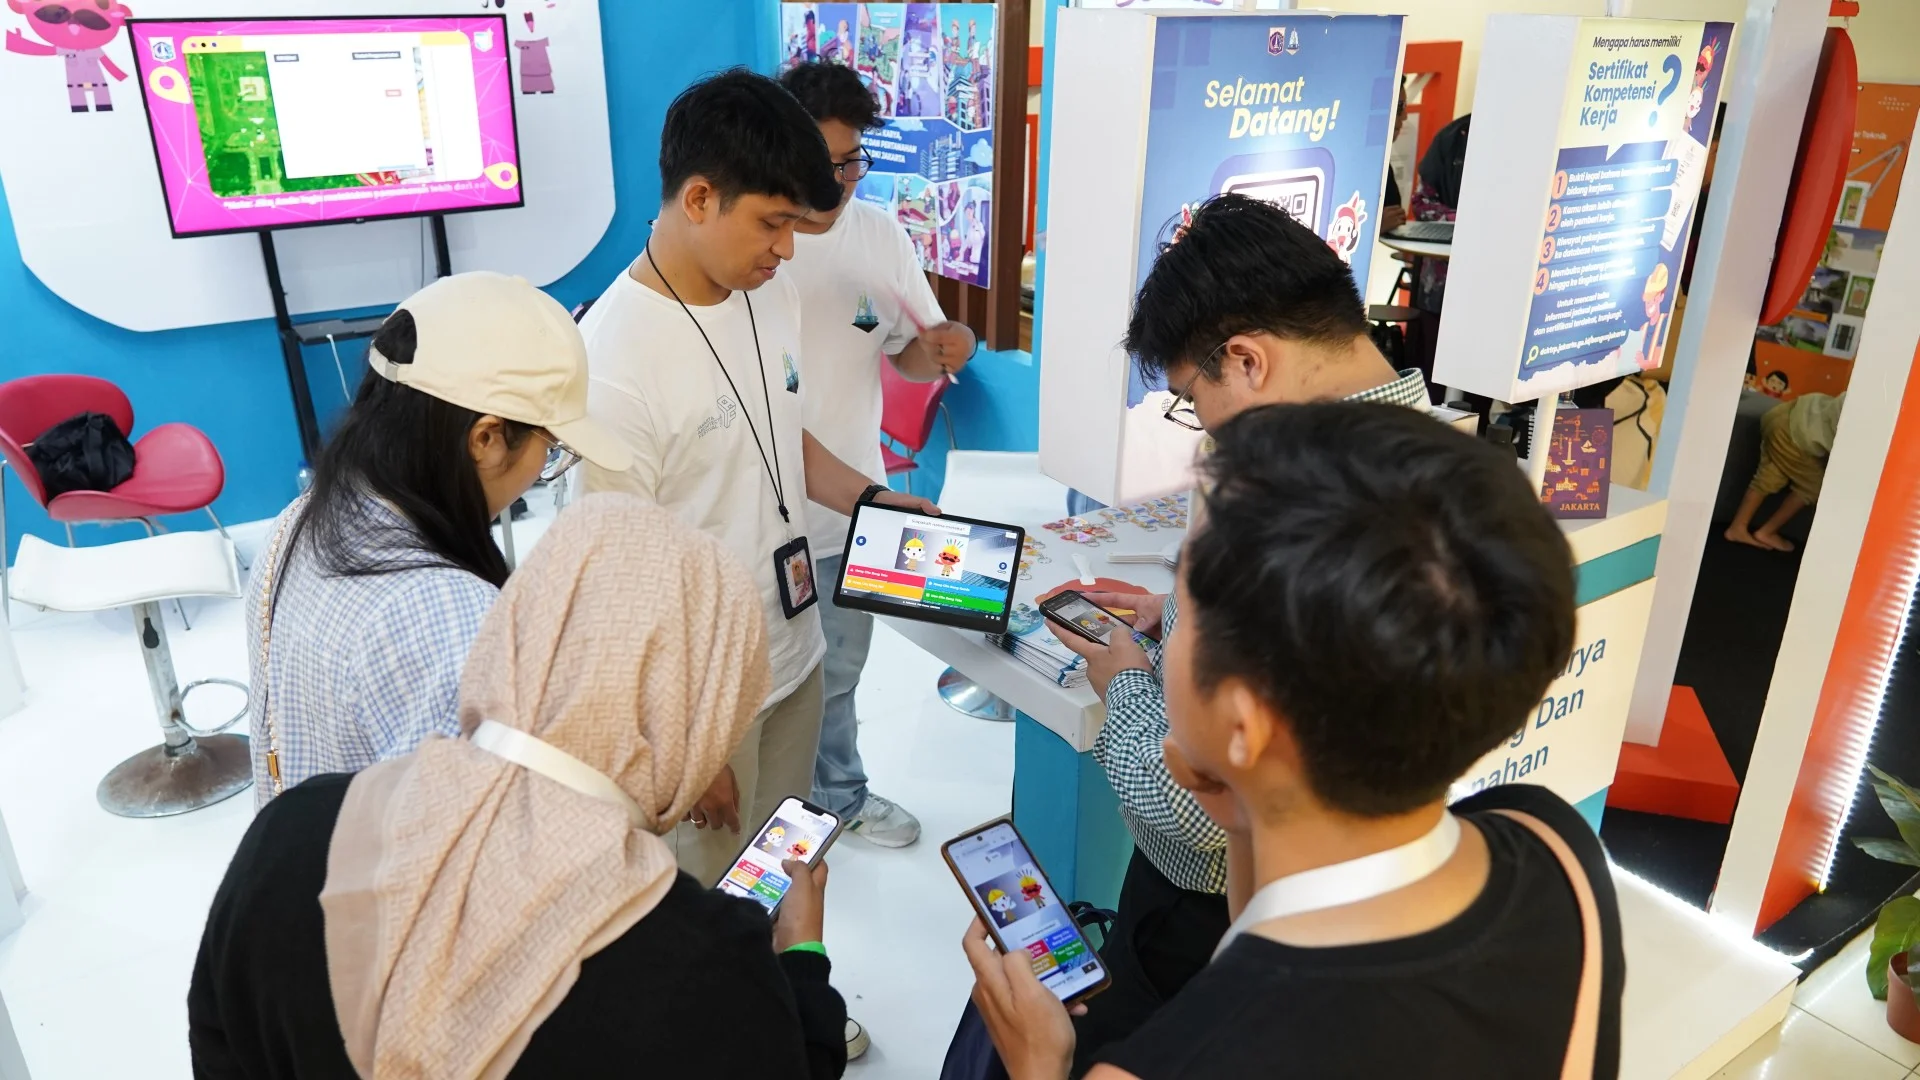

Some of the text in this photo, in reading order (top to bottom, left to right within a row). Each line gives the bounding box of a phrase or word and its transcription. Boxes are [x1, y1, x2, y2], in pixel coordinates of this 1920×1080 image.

[1593, 35, 1682, 52] Mengapa harus memiliki
[1588, 59, 1649, 80] Sertifikat
[1204, 76, 1305, 108] Selamat
[1583, 81, 1657, 107] Kompetensi
[1228, 99, 1341, 142] Datang!
[1579, 105, 1618, 131] Kerja
[881, 151, 906, 164] JAKARTA
[1556, 175, 1564, 195] 1
[1569, 172, 1586, 182] Bukti
[1585, 171, 1601, 183] legal
[1566, 186, 1589, 197] bidang
[1562, 205, 1581, 215] Kamu
[1581, 203, 1597, 213] akan
[1597, 200, 1612, 210] lebih
[1548, 209, 1557, 227] 2
[1560, 218, 1573, 228] oleh
[1573, 214, 1600, 229] pemberi
[1556, 236, 1581, 247] Riwayat
[1542, 243, 1551, 260] 3
[1554, 246, 1591, 259] ke database
[1551, 265, 1581, 278] Membuka
[1535, 274, 1545, 290] 4
[1549, 280, 1570, 292] hingga
[1570, 278, 1578, 287] ke
[1557, 298, 1574, 308] Untuk
[1573, 292, 1597, 304] mencari
[1545, 309, 1572, 322] informasi
[1571, 305, 1591, 318] jadwal
[1534, 327, 1545, 336] dan
[1546, 320, 1574, 333] sertifikasi
[1560, 503, 1600, 511] JAKARTA
[1558, 638, 1606, 678] rya
[1535, 688, 1584, 730] Dan
[1471, 746, 1549, 792] nahan
